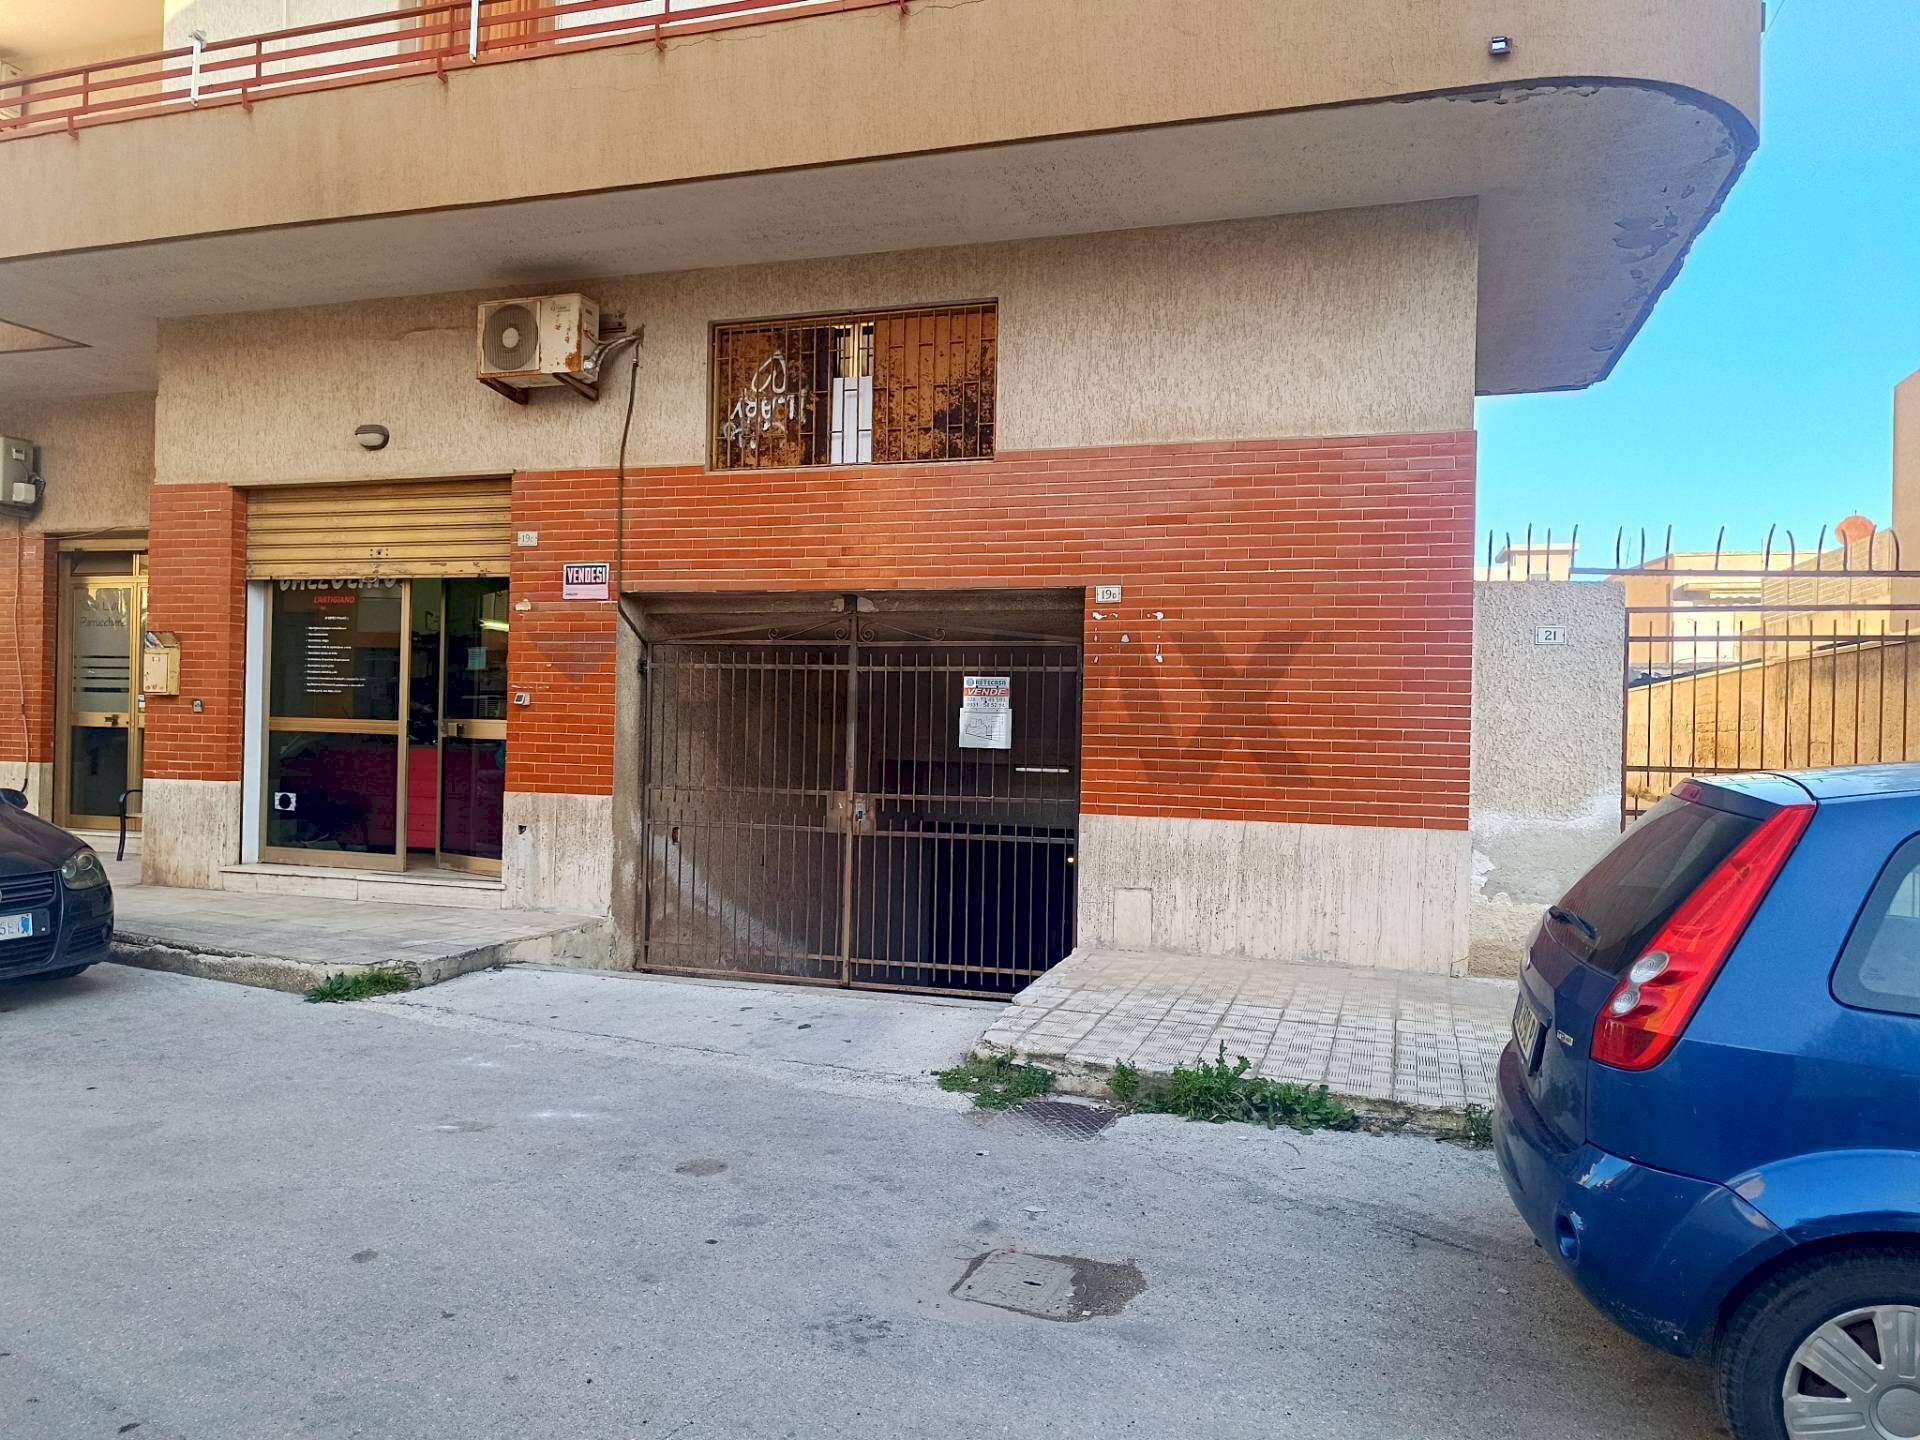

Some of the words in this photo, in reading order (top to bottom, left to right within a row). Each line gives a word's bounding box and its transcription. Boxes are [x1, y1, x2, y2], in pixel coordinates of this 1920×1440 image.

[566, 567, 606, 584] VENDESI
[1544, 629, 1557, 641] 21
[967, 688, 1007, 696] VENDE
